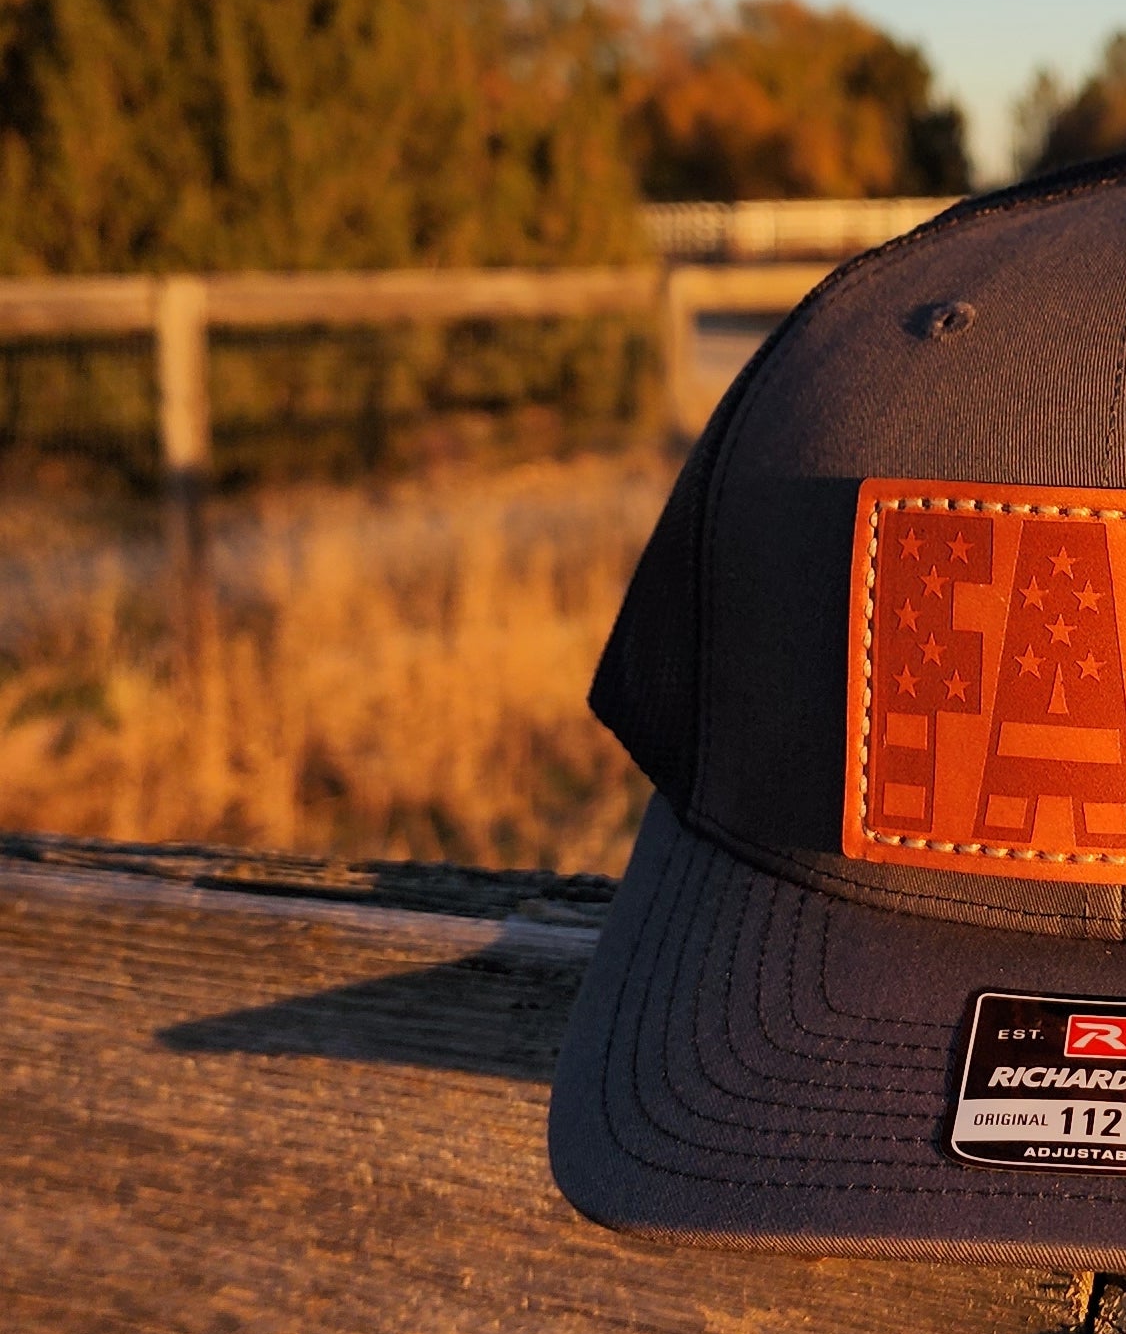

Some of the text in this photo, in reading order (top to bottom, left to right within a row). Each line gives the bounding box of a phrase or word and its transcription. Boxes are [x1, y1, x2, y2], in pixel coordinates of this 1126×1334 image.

[997, 1028, 1045, 1041] EST.
[973, 1113, 1049, 1127] ORIGINAL
[1060, 1107, 1123, 1137] 112
